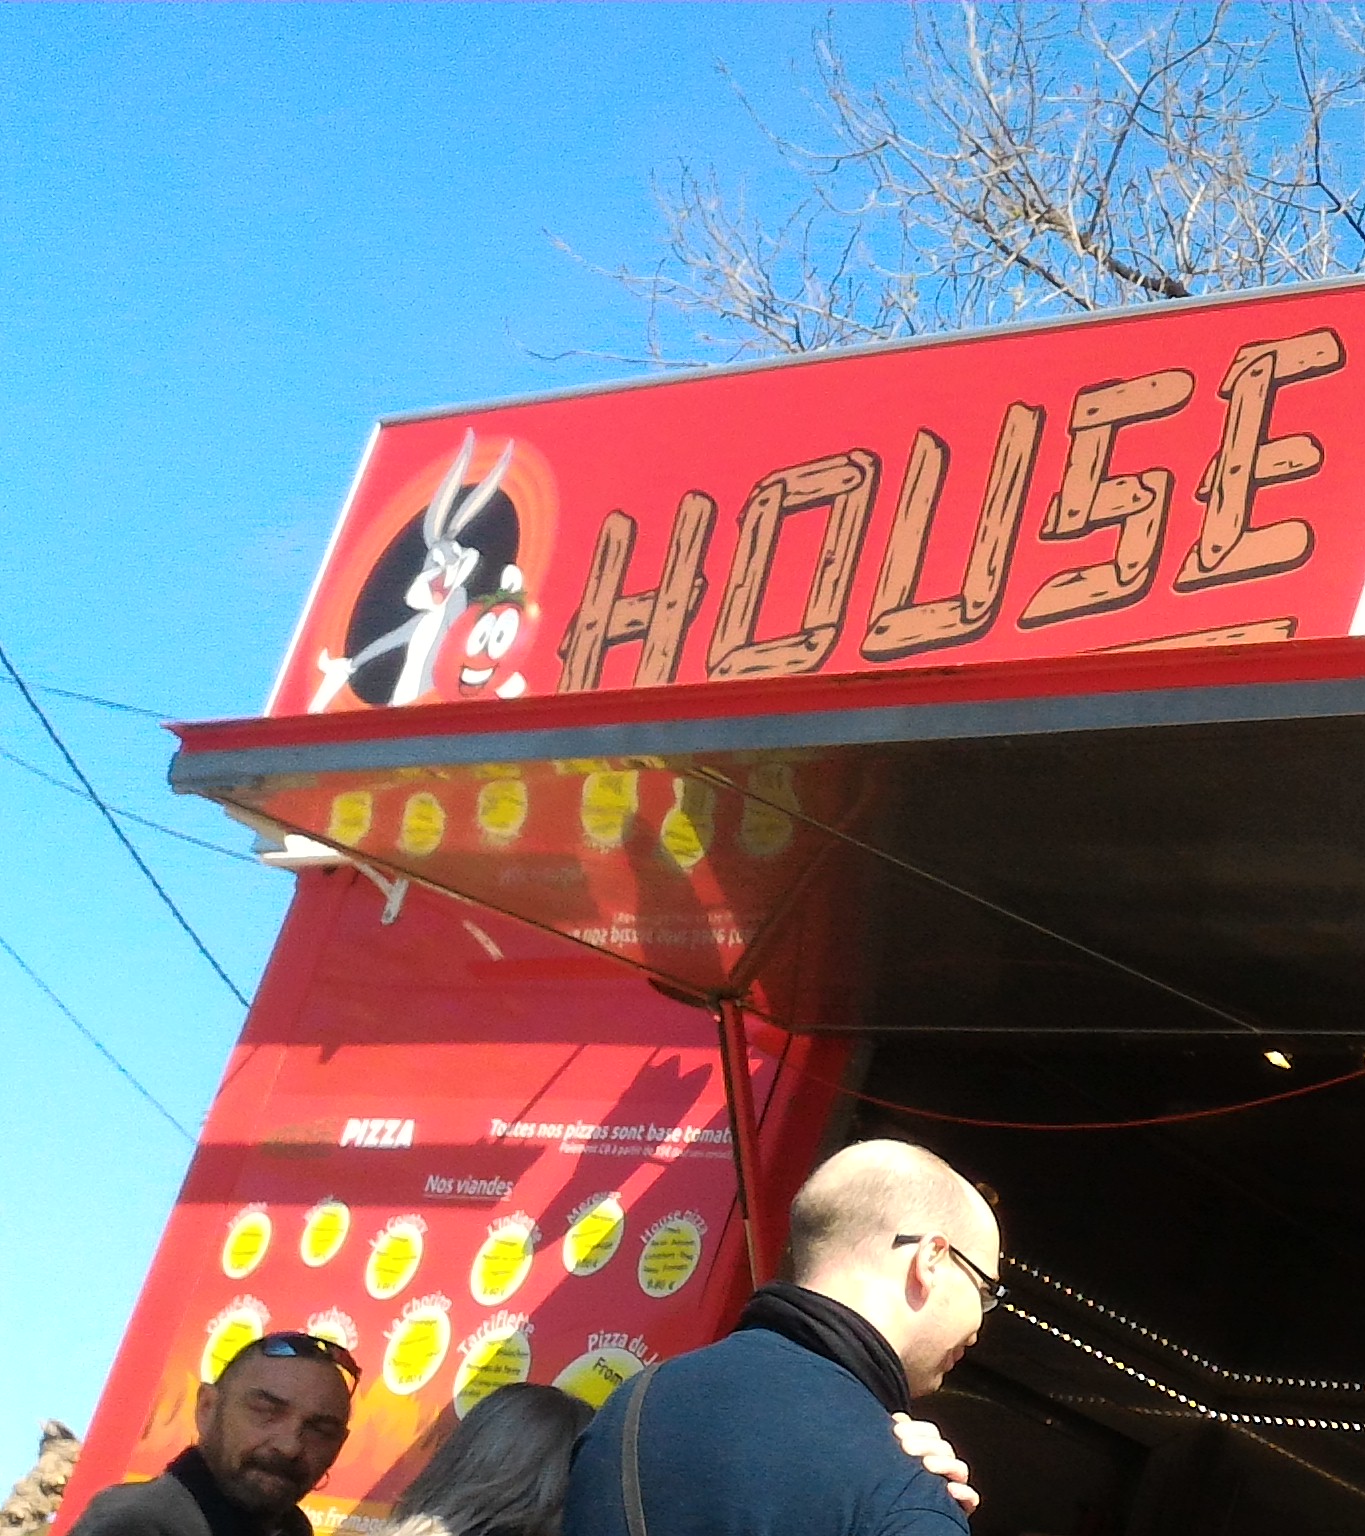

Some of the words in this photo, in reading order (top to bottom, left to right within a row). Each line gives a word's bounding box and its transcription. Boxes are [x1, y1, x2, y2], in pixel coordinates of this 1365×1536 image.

[558, 328, 1346, 693] HOUSE
[338, 1118, 415, 1148] PIZZA
[537, 1122, 564, 1139] nos
[564, 1120, 609, 1142] pizzas
[610, 1124, 643, 1140] sont
[648, 1123, 681, 1143] base
[424, 1174, 453, 1194] Nos
[456, 1175, 514, 1197] viandes
[587, 1329, 629, 1352] Pizza
